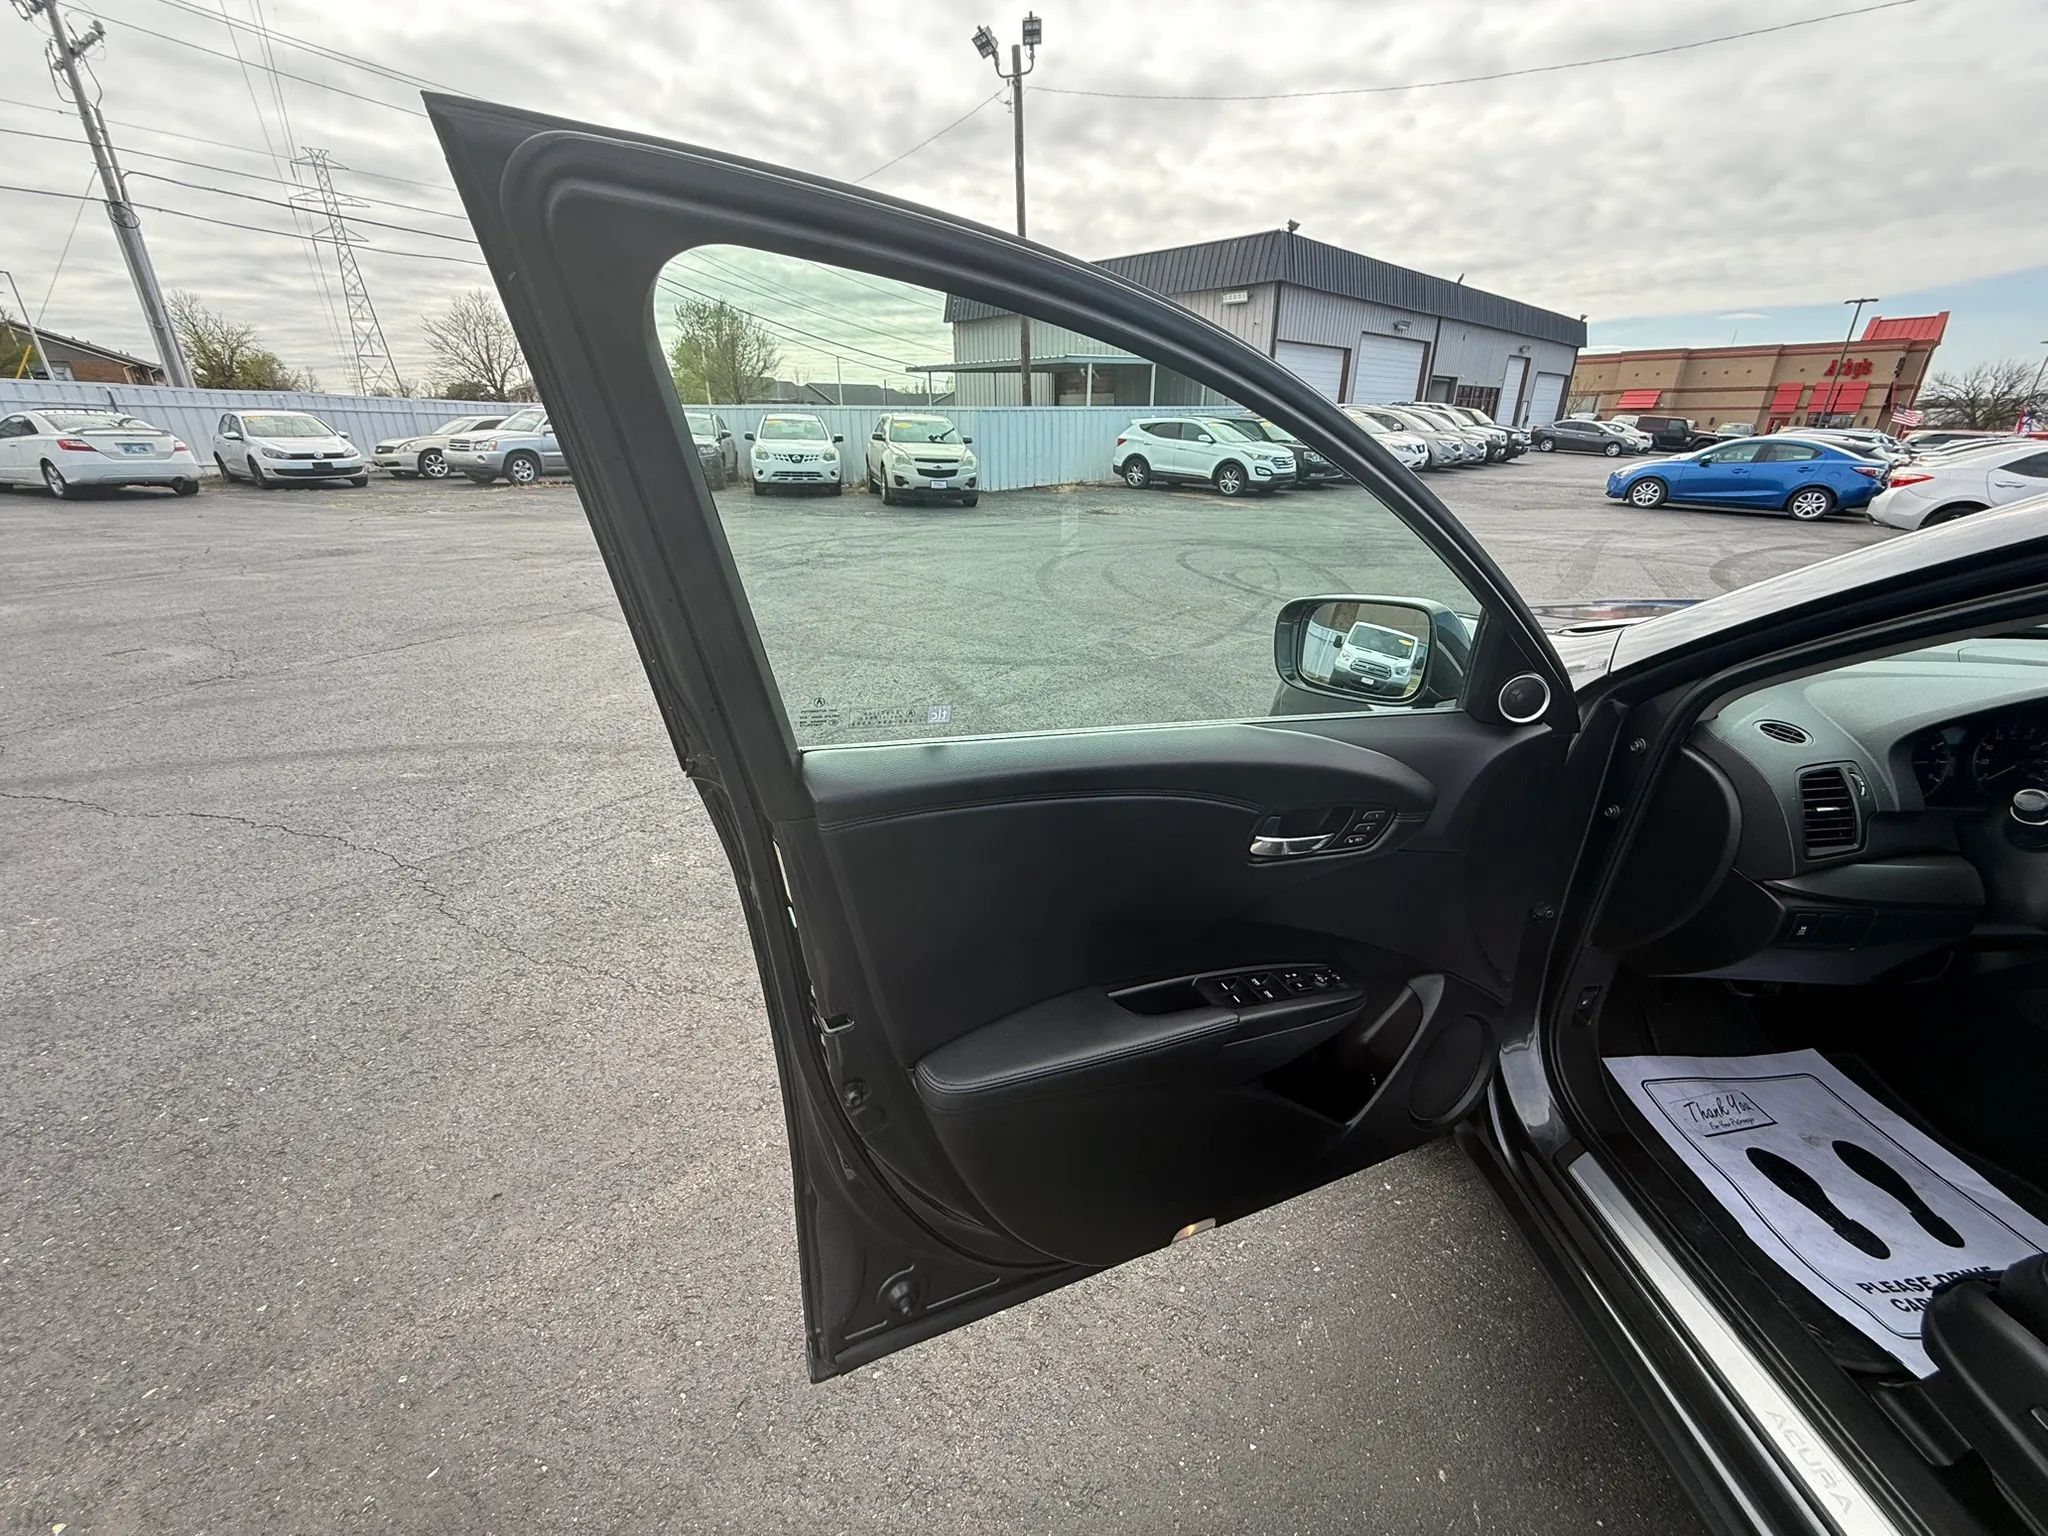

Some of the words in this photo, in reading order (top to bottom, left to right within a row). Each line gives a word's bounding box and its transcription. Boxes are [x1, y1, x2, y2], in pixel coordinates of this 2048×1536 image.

[1683, 1096, 1729, 1122] Thank
[1726, 1094, 1753, 1114] You
[1855, 1275, 1933, 1294] PLEASE
[1766, 1410, 1852, 1514] ACURA
